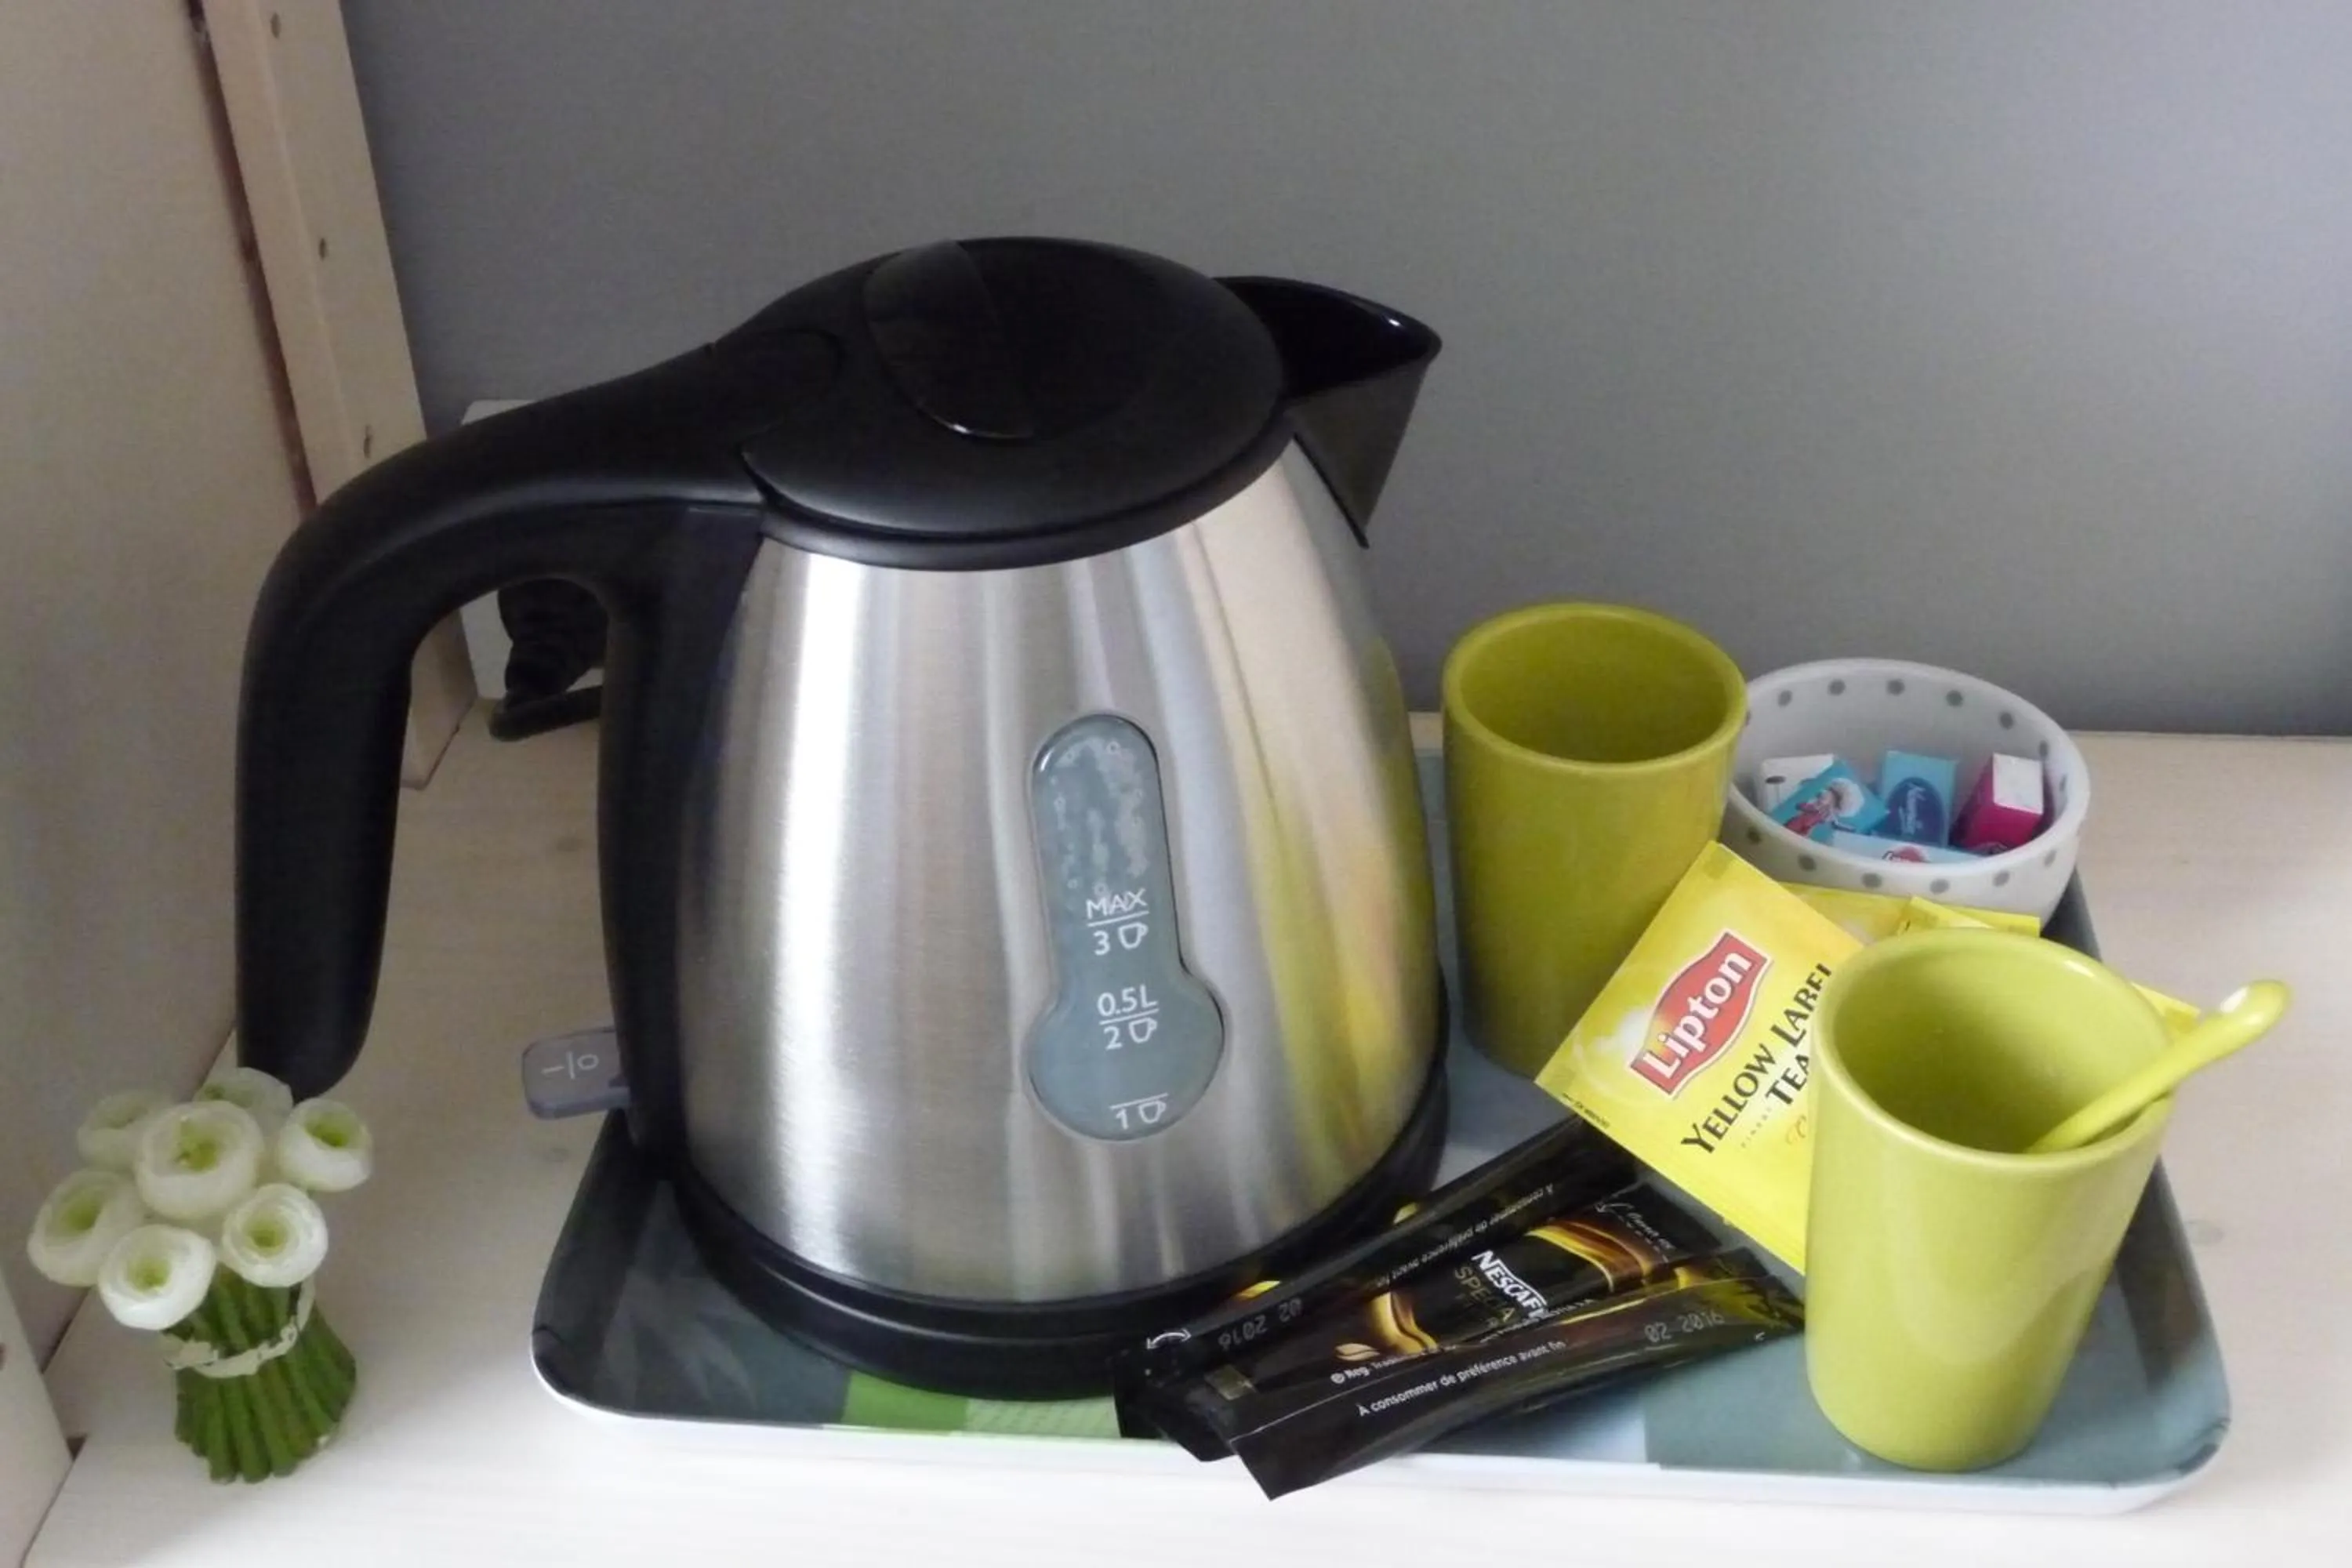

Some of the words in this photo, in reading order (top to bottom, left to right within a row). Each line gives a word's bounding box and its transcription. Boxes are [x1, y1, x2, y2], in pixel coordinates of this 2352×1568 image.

[1086, 888, 1148, 920] MAX
[1094, 931, 1111, 956] 3
[1098, 984, 1158, 1018] 0.5L
[1642, 952, 1752, 1080] Lipton
[1104, 1024, 1123, 1051] 2
[1766, 1054, 1810, 1105] TEA
[1681, 1042, 1777, 1155] YELLOW
[1115, 1107, 1129, 1129] 1
[1644, 1321, 1672, 1343] 02
[1370, 1380, 1439, 1412] consommer
[1439, 1374, 1457, 1387] de
